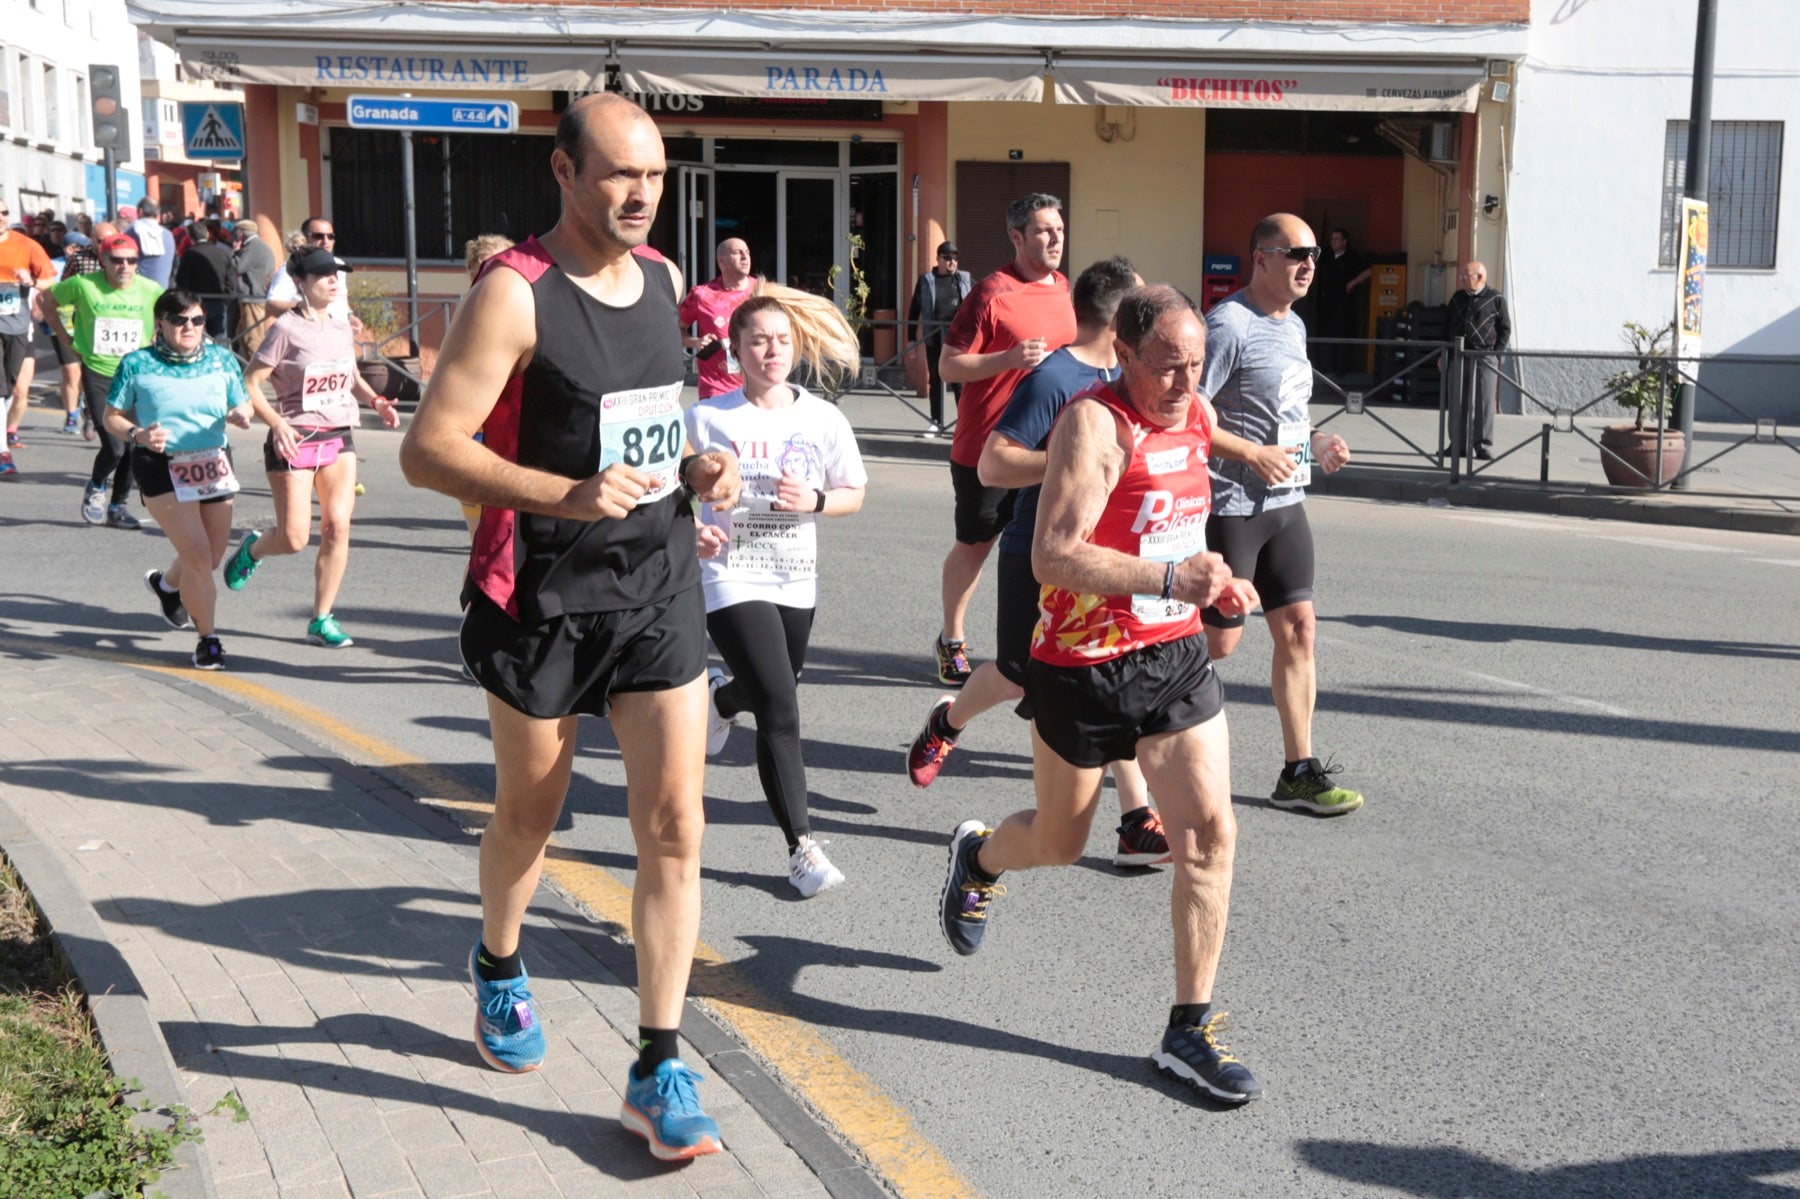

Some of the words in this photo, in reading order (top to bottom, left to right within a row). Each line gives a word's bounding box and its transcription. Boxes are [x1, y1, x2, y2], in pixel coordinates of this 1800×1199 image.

[315, 55, 530, 83] RESTAURANTE
[765, 66, 888, 92] PARADA
[1381, 88, 1421, 99] CERVEZAS
[352, 105, 419, 121] Granada
[454, 111, 485, 122] A-44
[101, 329, 138, 343] 3112
[306, 373, 348, 395] 2267
[622, 419, 681, 468] 820
[731, 440, 769, 459] VII
[174, 459, 229, 484] 2083
[746, 522, 777, 530] CORRO
[746, 541, 777, 550] aecc
